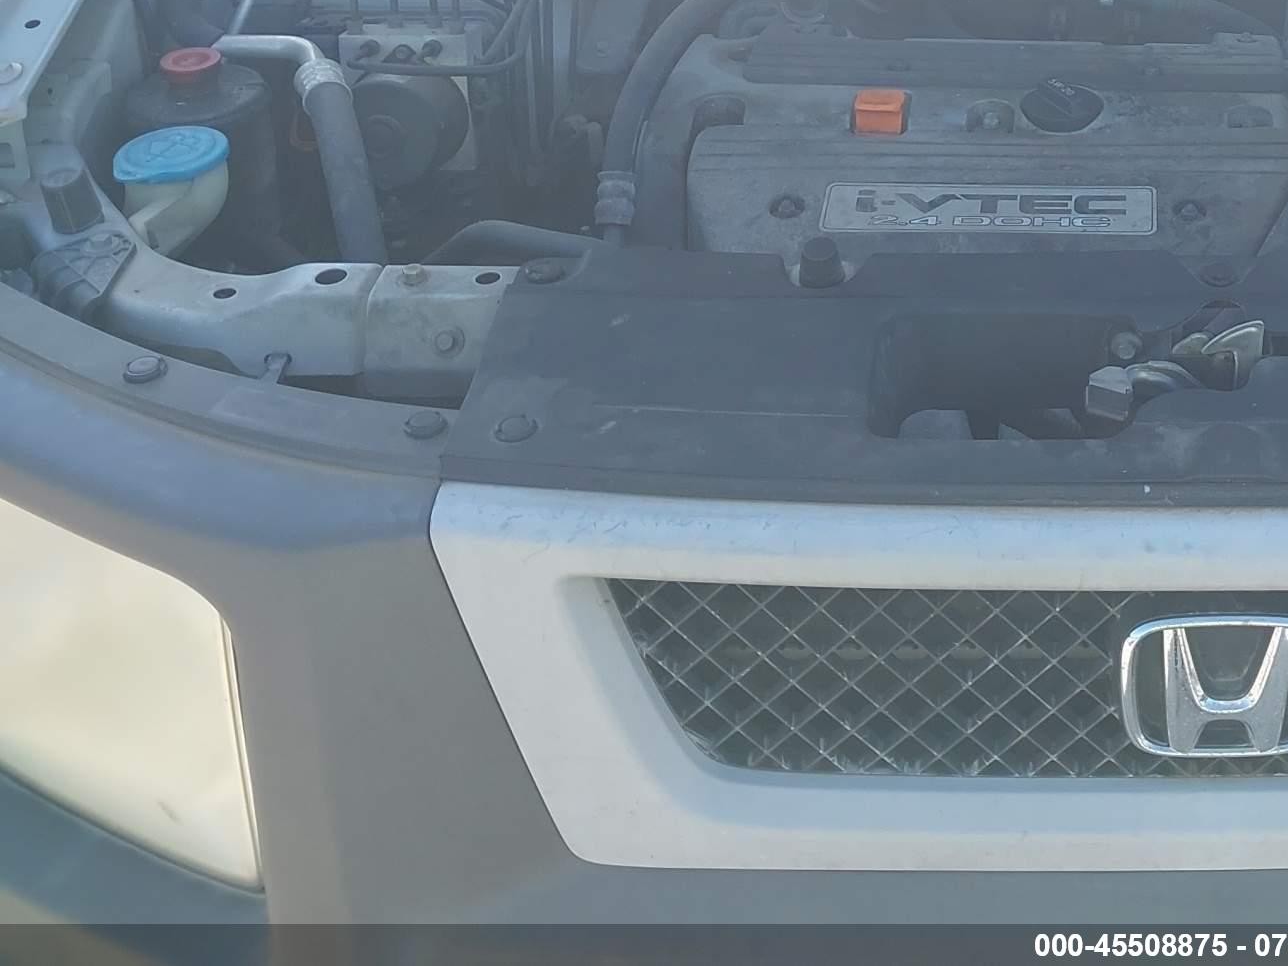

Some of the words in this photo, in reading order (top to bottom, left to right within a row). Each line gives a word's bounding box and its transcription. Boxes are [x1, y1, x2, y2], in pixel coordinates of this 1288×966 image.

[856, 189, 1127, 215] i-VTEC
[868, 215, 942, 227] 2.4
[952, 215, 1112, 227] DOHC
